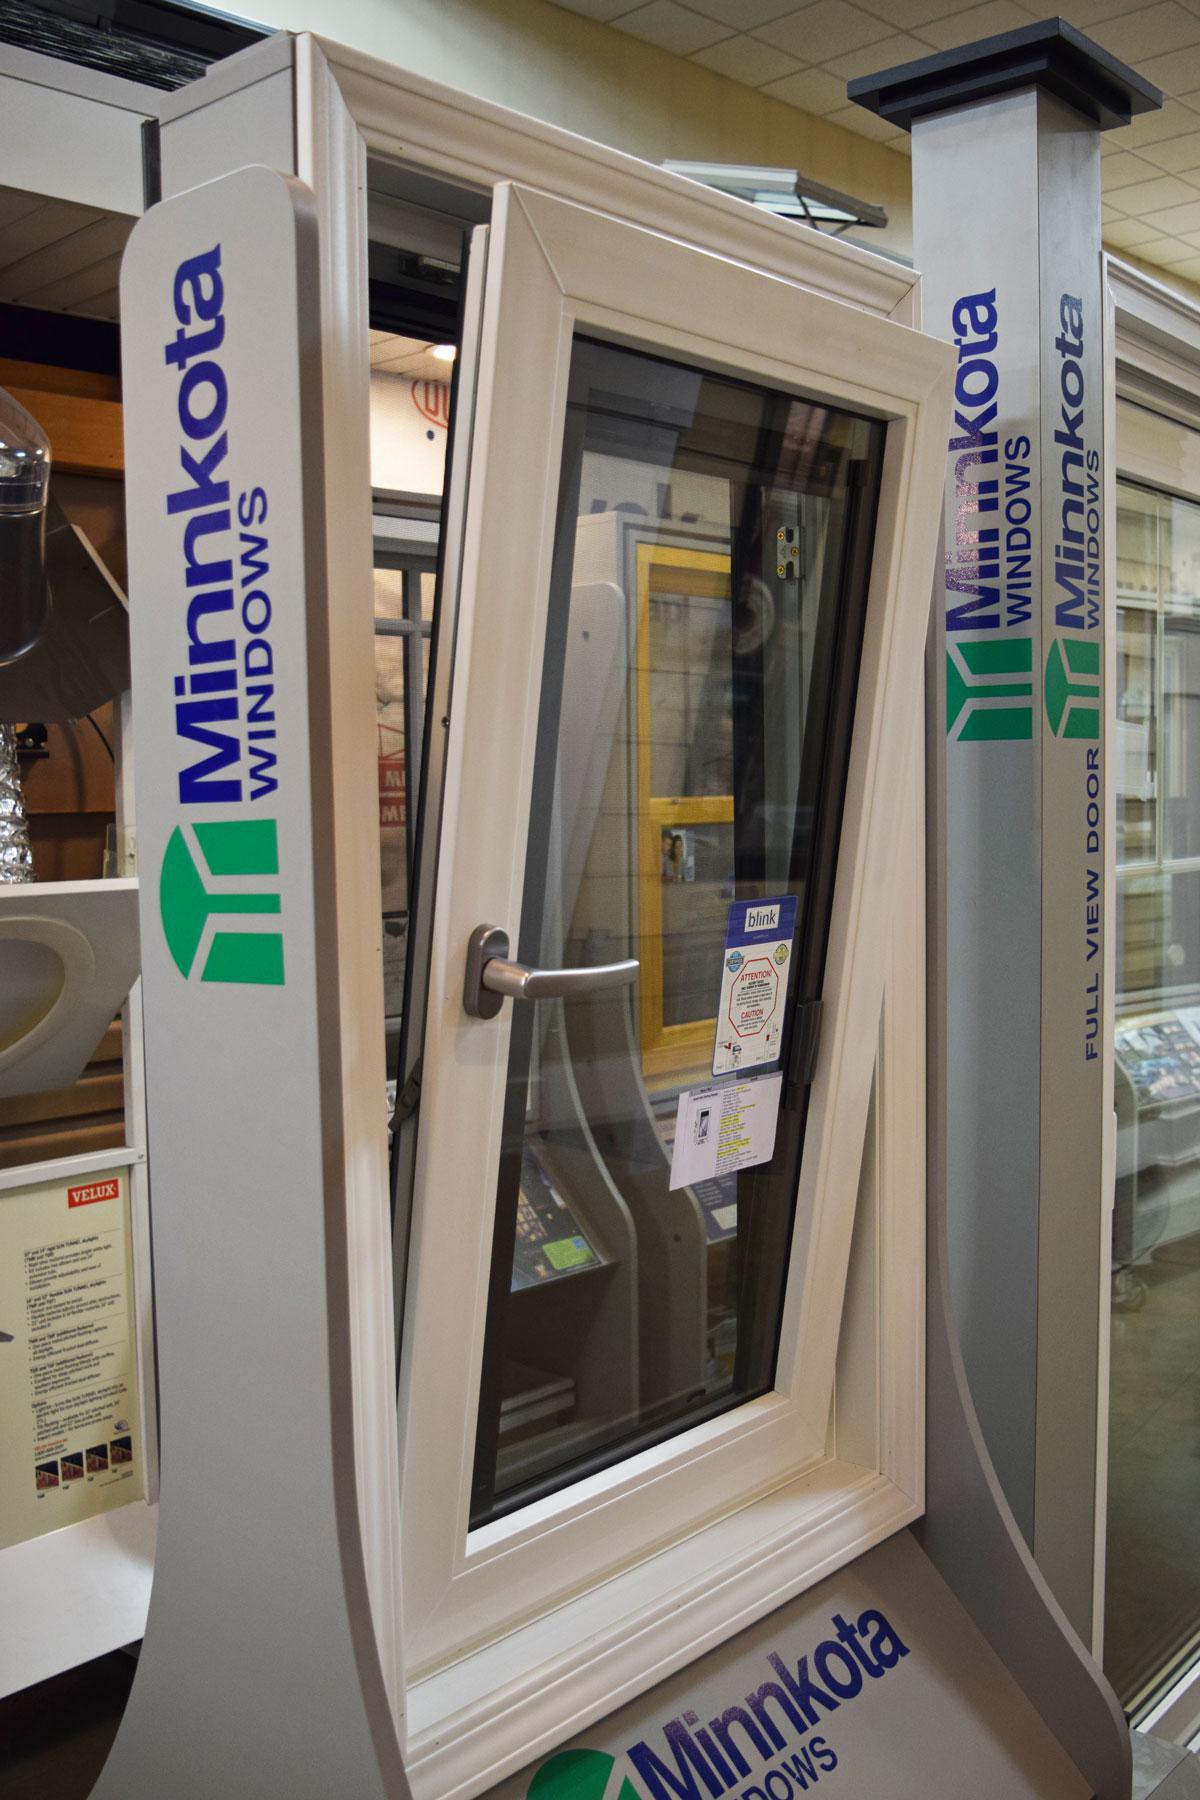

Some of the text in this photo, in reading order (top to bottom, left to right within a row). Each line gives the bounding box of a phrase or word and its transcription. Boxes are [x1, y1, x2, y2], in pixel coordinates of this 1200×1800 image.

[165, 242, 243, 804] Minnkota
[945, 287, 999, 632] Minnkota
[1004, 435, 1032, 627] WINDOWS
[1054, 292, 1085, 630] Minnkota
[1086, 449, 1100, 630] WINDOWS
[237, 486, 278, 801] WINDOWS
[747, 909, 776, 928] blink
[1085, 747, 1099, 1060] FULL VIEW DOOR
[741, 1008, 764, 1019] CAUTION
[72, 1183, 116, 1203] VELUX
[626, 1608, 911, 1800] Minnkota
